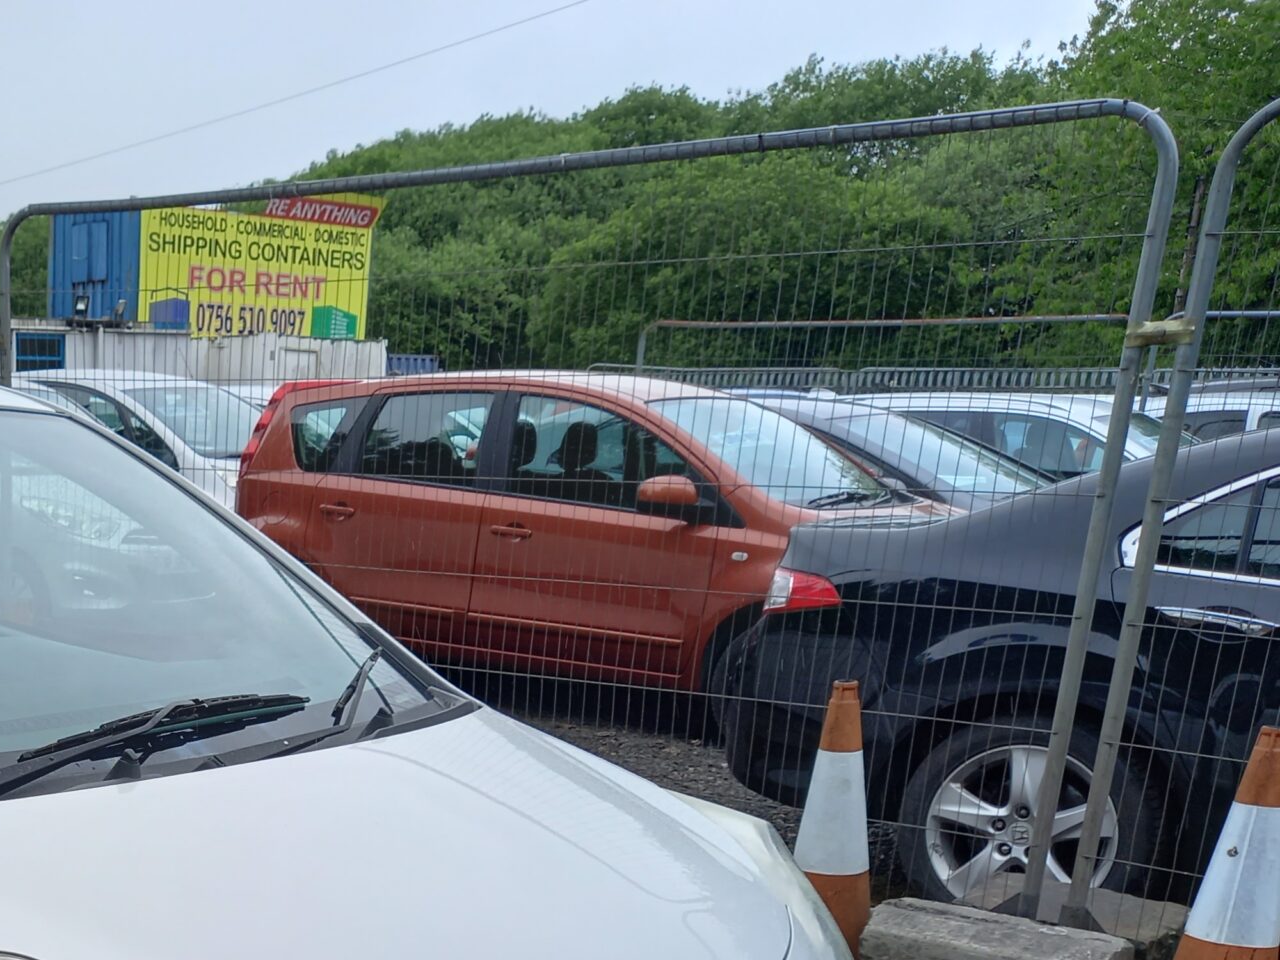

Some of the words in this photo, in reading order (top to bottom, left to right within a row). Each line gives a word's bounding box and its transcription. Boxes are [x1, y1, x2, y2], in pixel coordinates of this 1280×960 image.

[160, 211, 228, 233] HOUSEHOLD
[236, 220, 306, 242] COMMERCIAL
[314, 229, 366, 248] DOMESTIC
[289, 200, 372, 225] ANYTHING
[148, 232, 242, 260] SHIPPING
[248, 242, 365, 271] CONTAINERS
[188, 265, 246, 294] FOR
[255, 272, 327, 300] RENT
[196, 304, 233, 334] 0756
